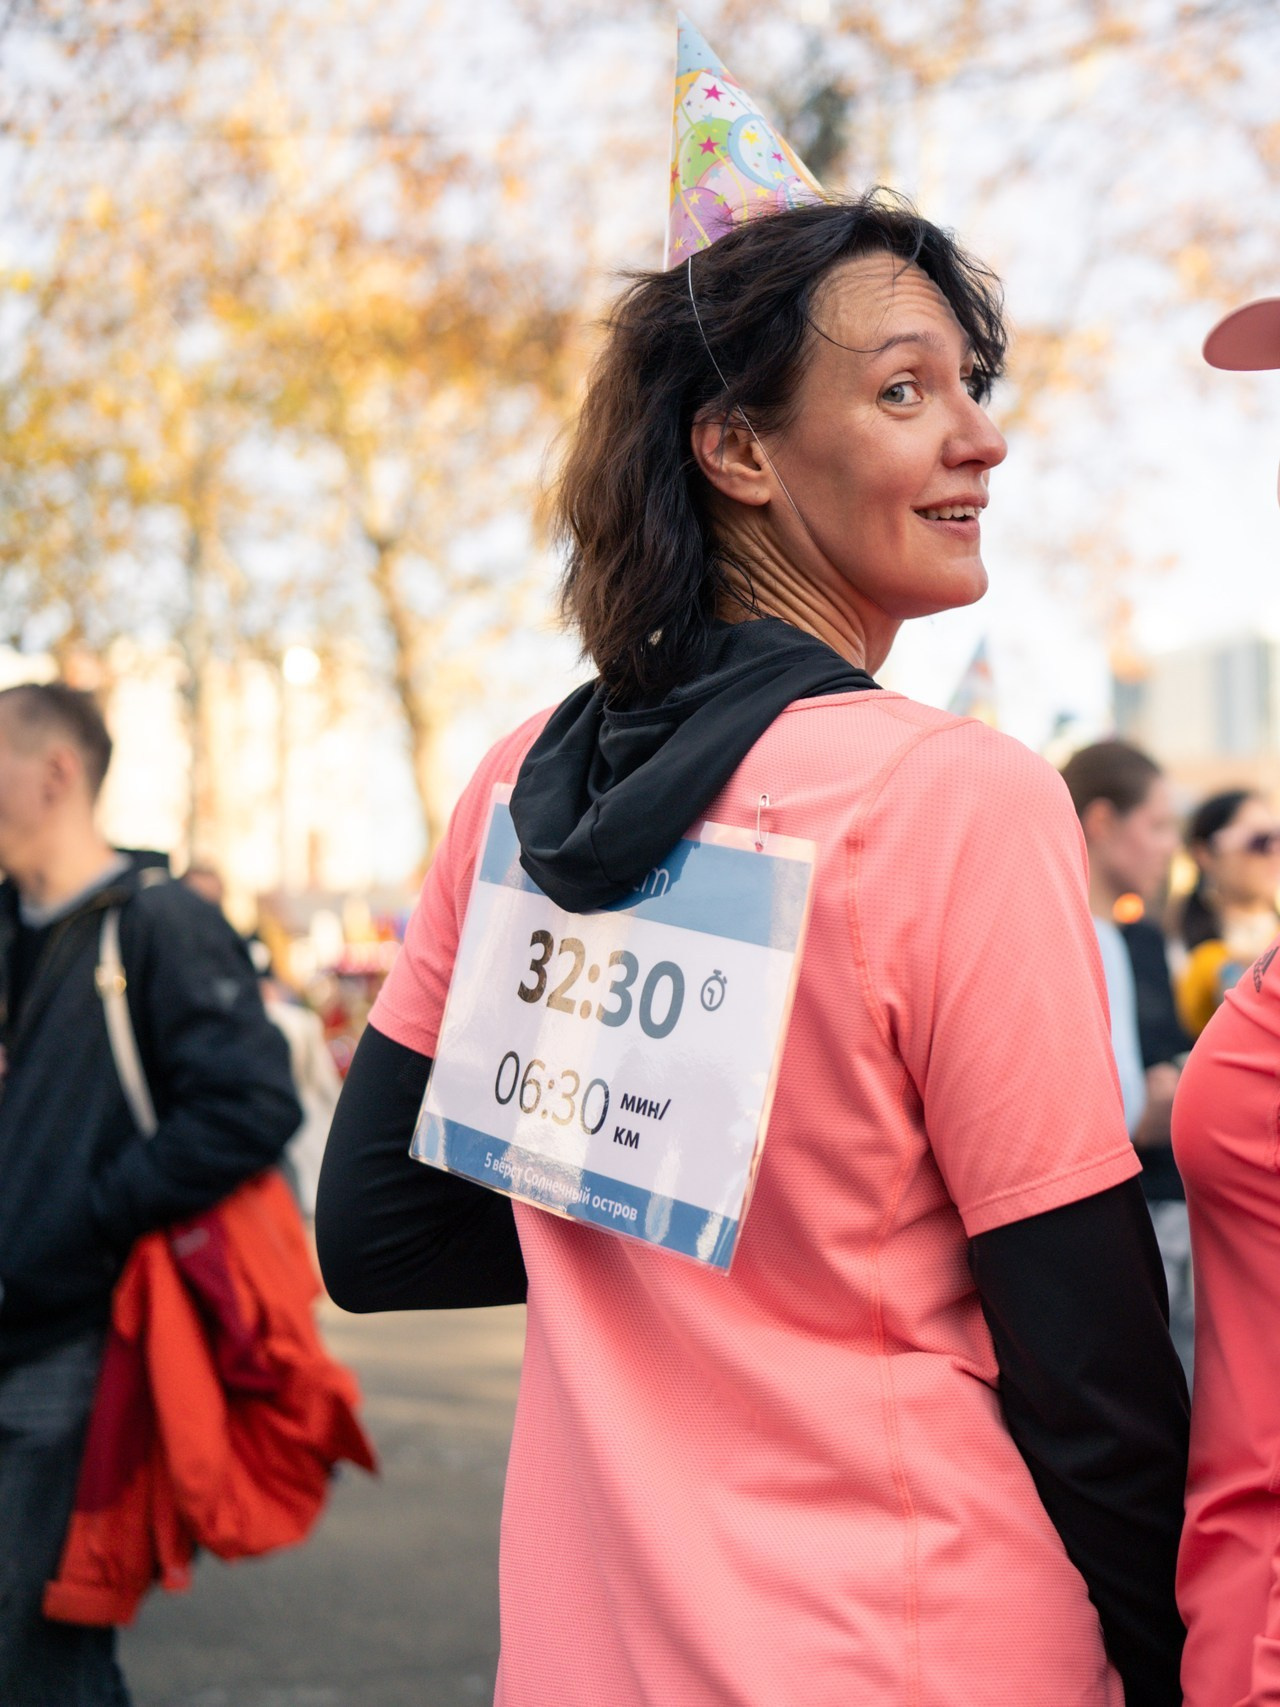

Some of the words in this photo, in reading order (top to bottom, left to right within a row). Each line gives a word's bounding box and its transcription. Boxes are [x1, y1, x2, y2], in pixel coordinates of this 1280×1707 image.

[517, 929, 685, 1039] 32:30
[494, 1050, 610, 1135] 06:30
[620, 1093, 671, 1120] мин/
[613, 1126, 640, 1149] км
[484, 1151, 493, 1168] 5
[492, 1157, 522, 1179] вёрст
[591, 1196, 639, 1222] остров
